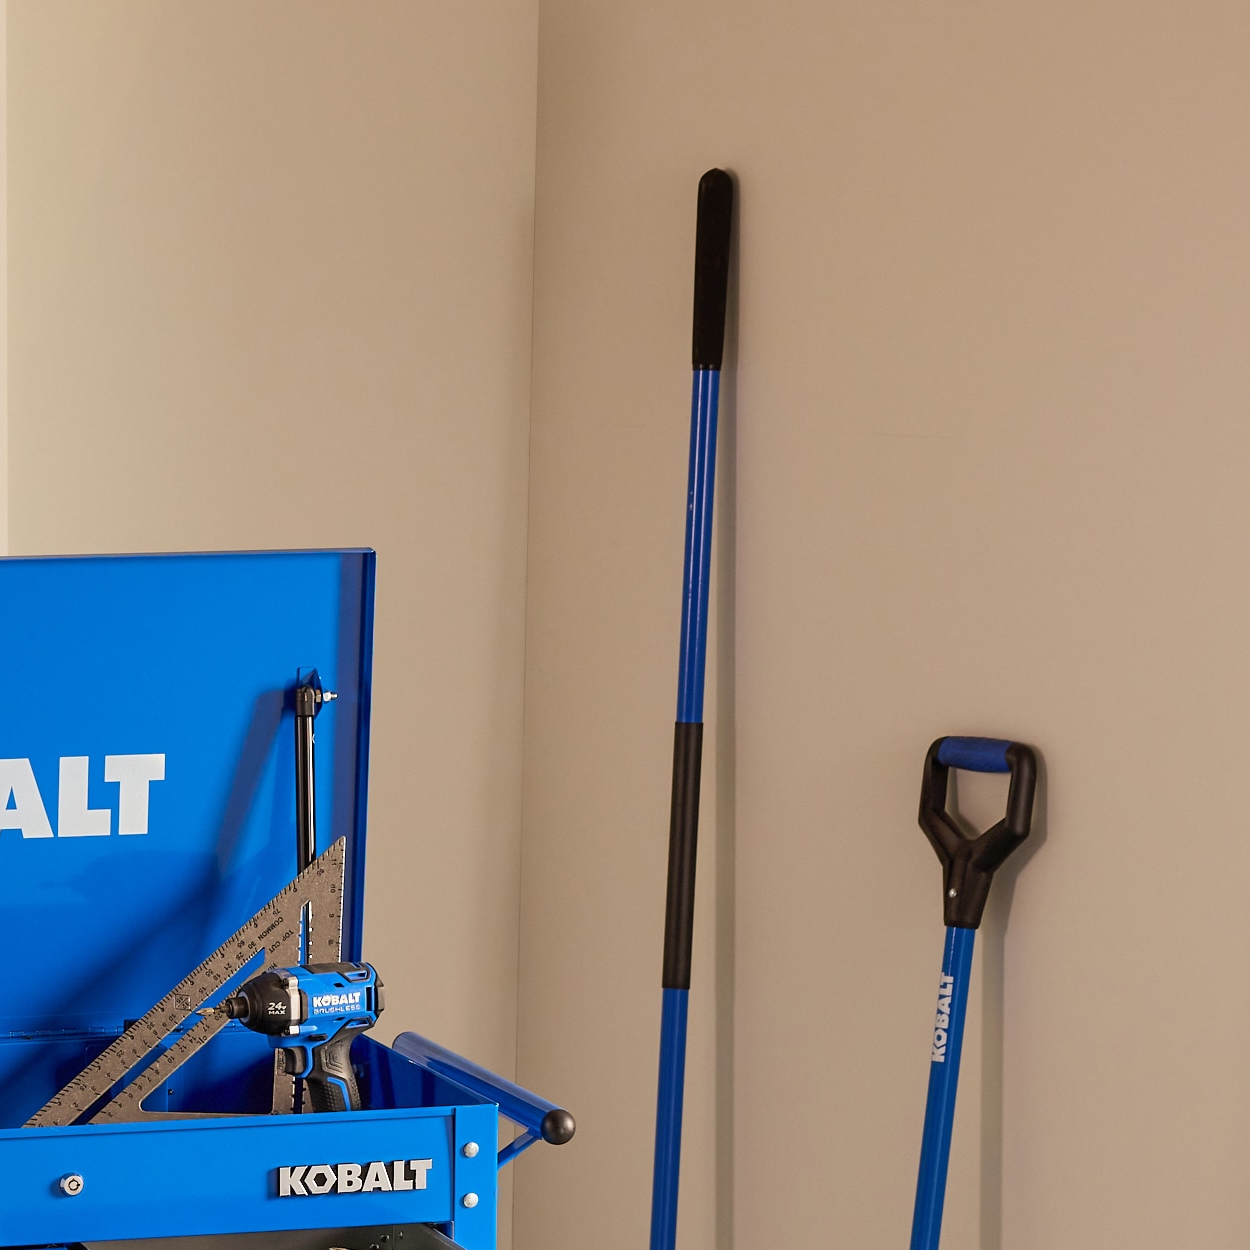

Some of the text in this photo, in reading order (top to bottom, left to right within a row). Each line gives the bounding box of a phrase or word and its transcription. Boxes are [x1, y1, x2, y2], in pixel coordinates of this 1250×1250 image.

[257, 916, 284, 941] COMMON
[268, 929, 294, 954] TOP CUT
[312, 991, 361, 1008] KOBALT
[313, 1004, 361, 1015] BRUSHLESS
[931, 972, 954, 1062] KOBALT
[279, 1158, 433, 1197] KOBALT
